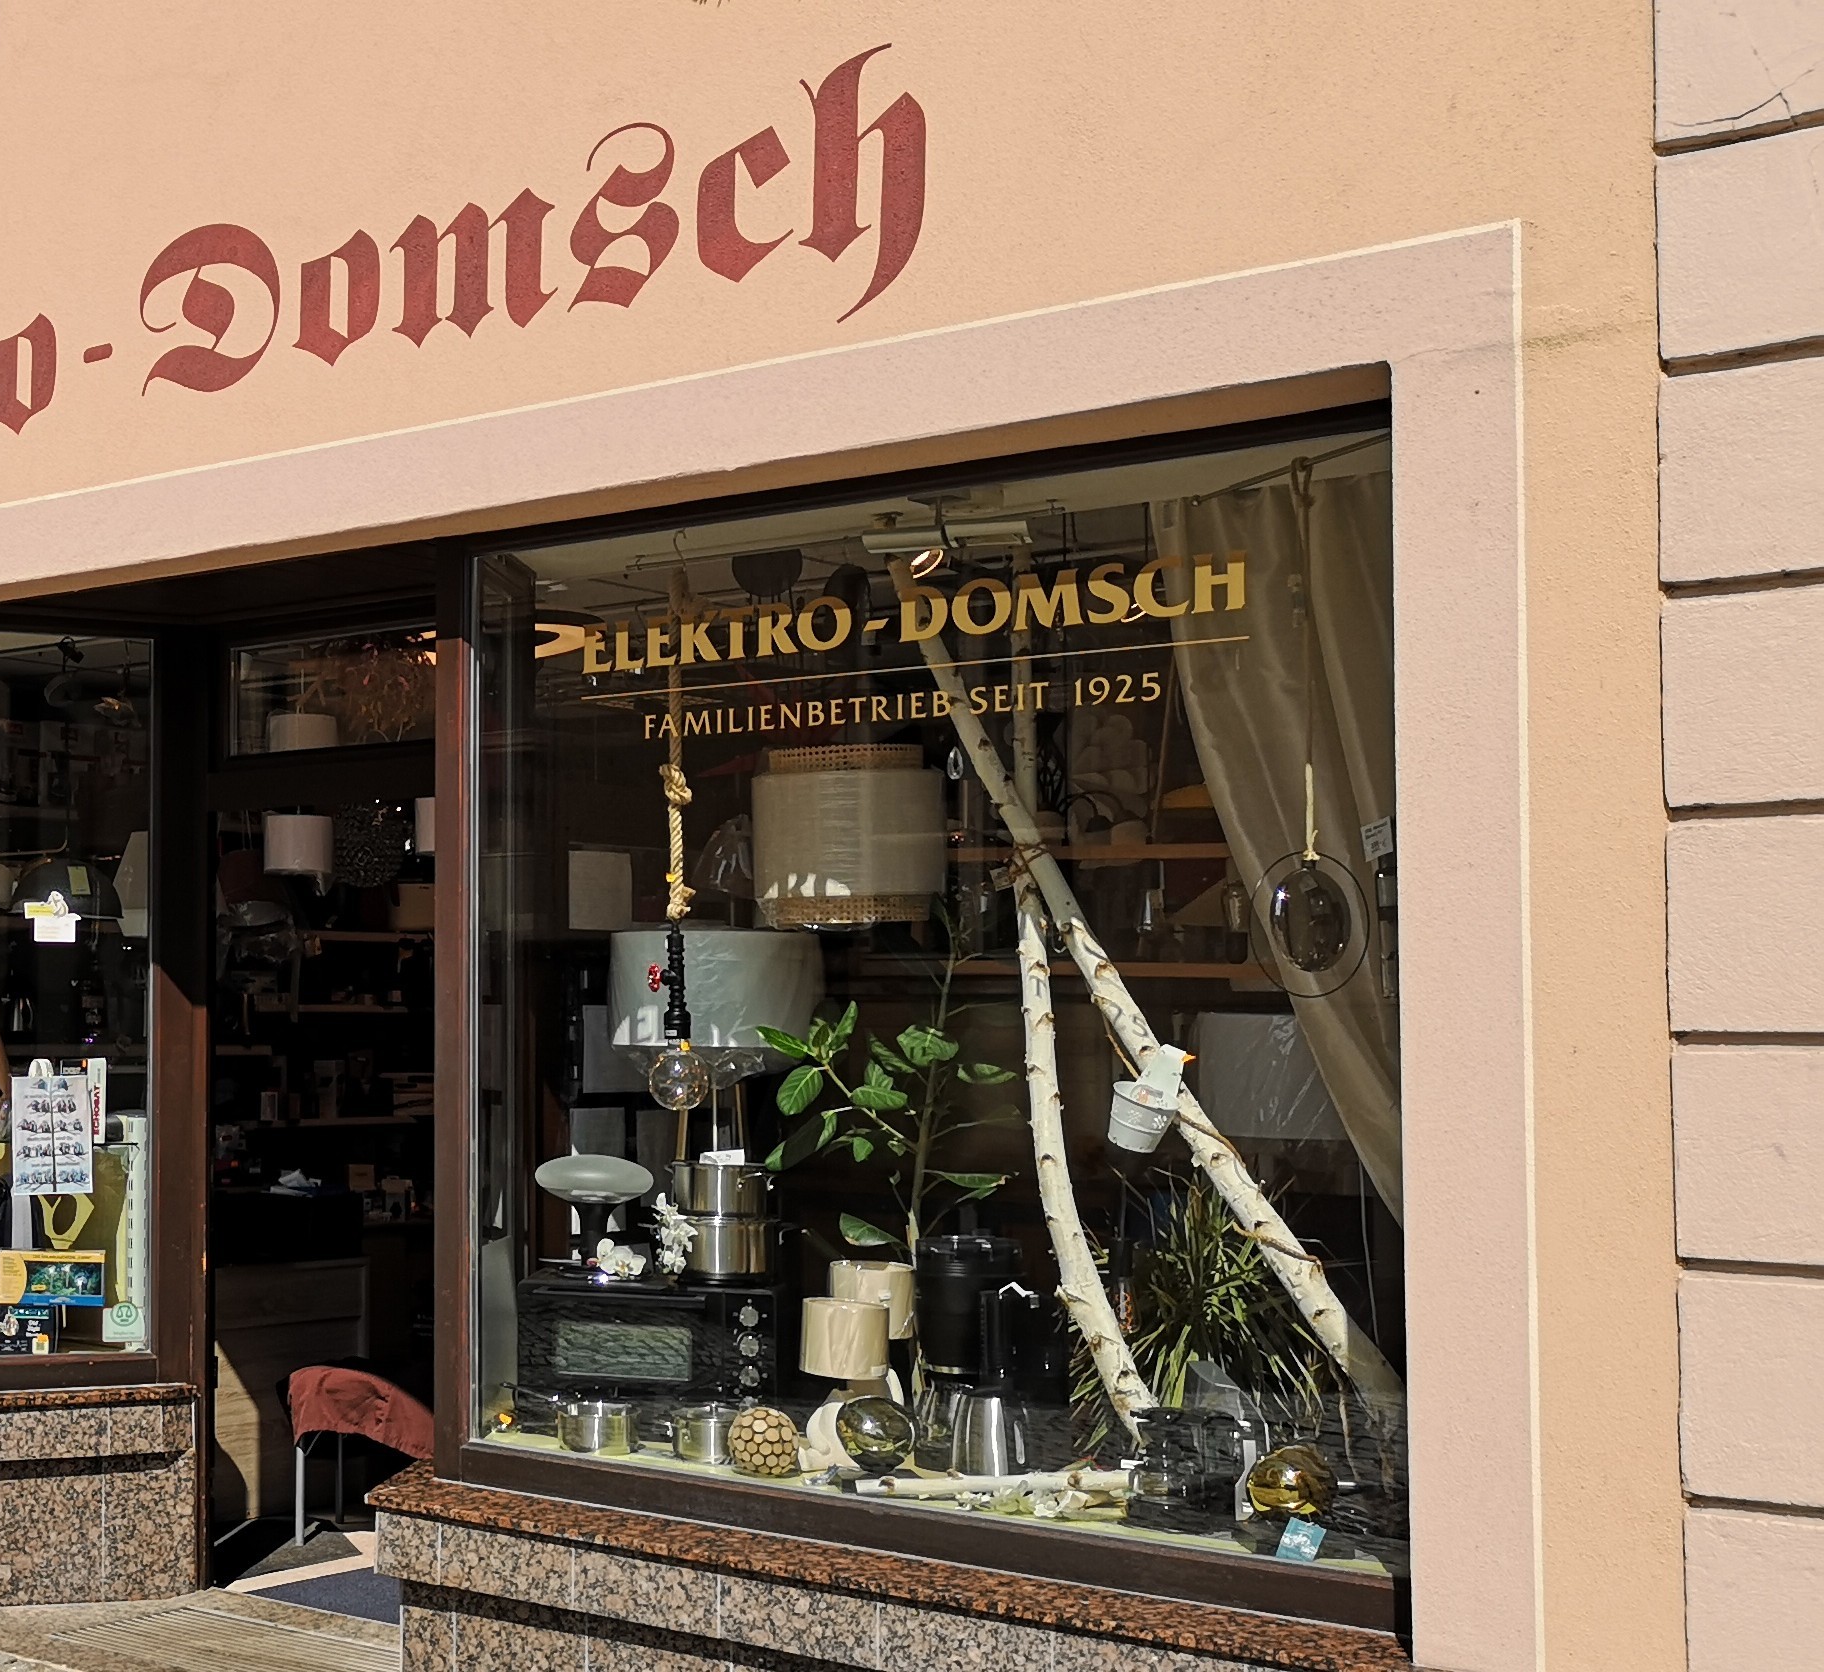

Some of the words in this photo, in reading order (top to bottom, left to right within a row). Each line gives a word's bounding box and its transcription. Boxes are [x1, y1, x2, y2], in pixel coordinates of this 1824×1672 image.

[644, 691, 952, 739] FAMILIENBETRIEB
[969, 681, 1049, 715] SEIT
[1074, 672, 1161, 706] 1925
